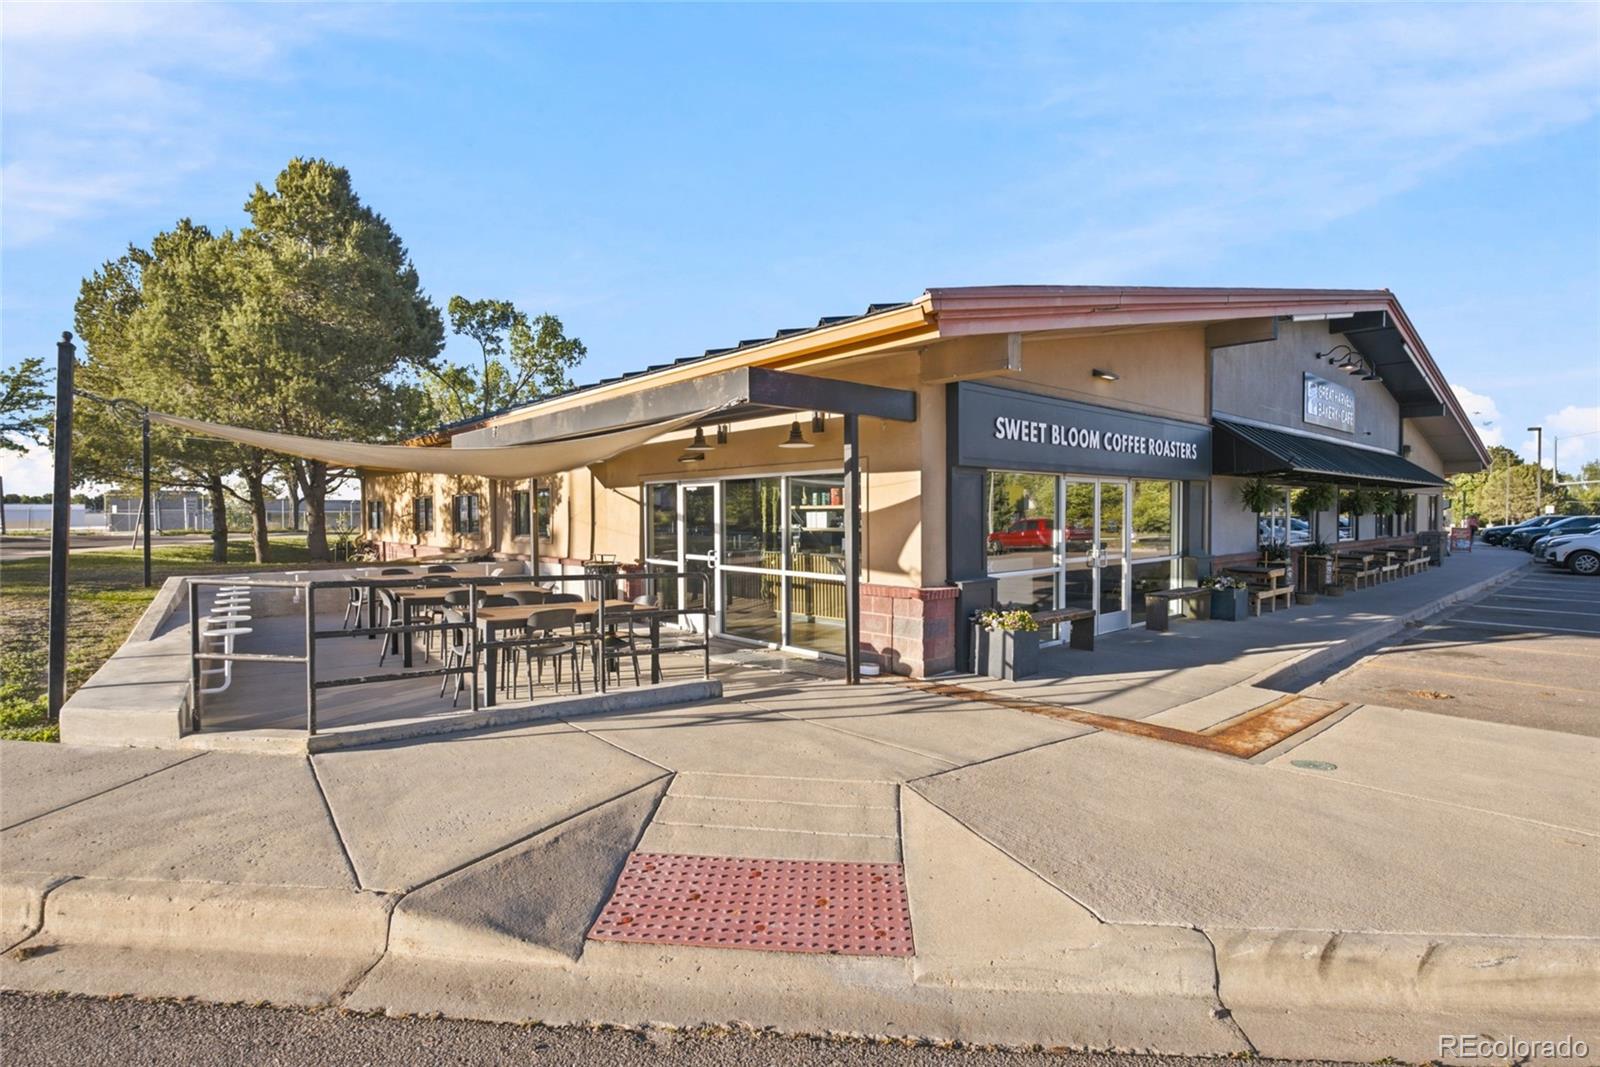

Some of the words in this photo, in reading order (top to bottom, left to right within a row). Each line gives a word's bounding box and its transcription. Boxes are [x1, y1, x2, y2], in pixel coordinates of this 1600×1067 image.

[995, 416, 1047, 443] SWEET
[1051, 424, 1100, 449] BLOOM
[1104, 432, 1146, 455] COFFEE
[1149, 439, 1197, 460] ROASTERS
